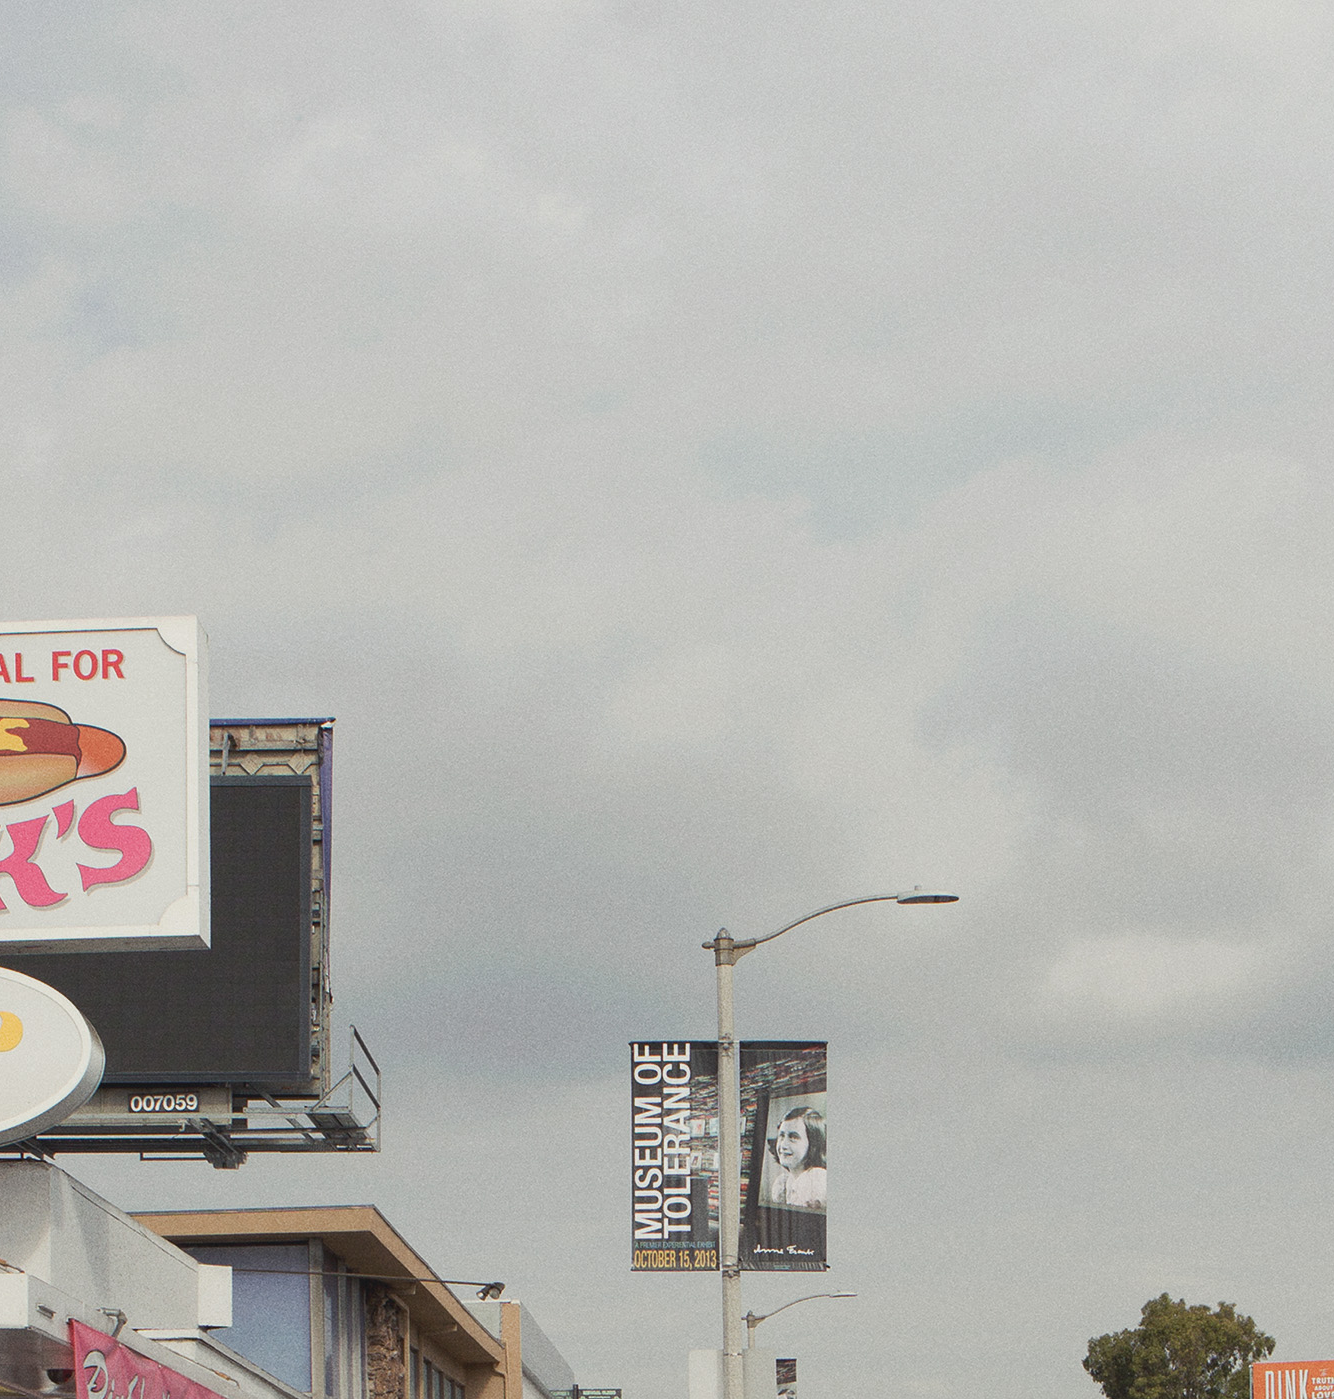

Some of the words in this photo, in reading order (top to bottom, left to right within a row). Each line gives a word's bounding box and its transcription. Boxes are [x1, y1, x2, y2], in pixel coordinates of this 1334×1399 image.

[51, 649, 125, 680] FOR
[633, 1044, 662, 1085] OF
[130, 1093, 198, 1112] 007059
[662, 1042, 691, 1239] TOLERANCE
[634, 1096, 663, 1240] MUSEUM
[634, 1249, 677, 1268] OCTOBER
[678, 1249, 693, 1270] 15,
[694, 1249, 717, 1268] 2013
